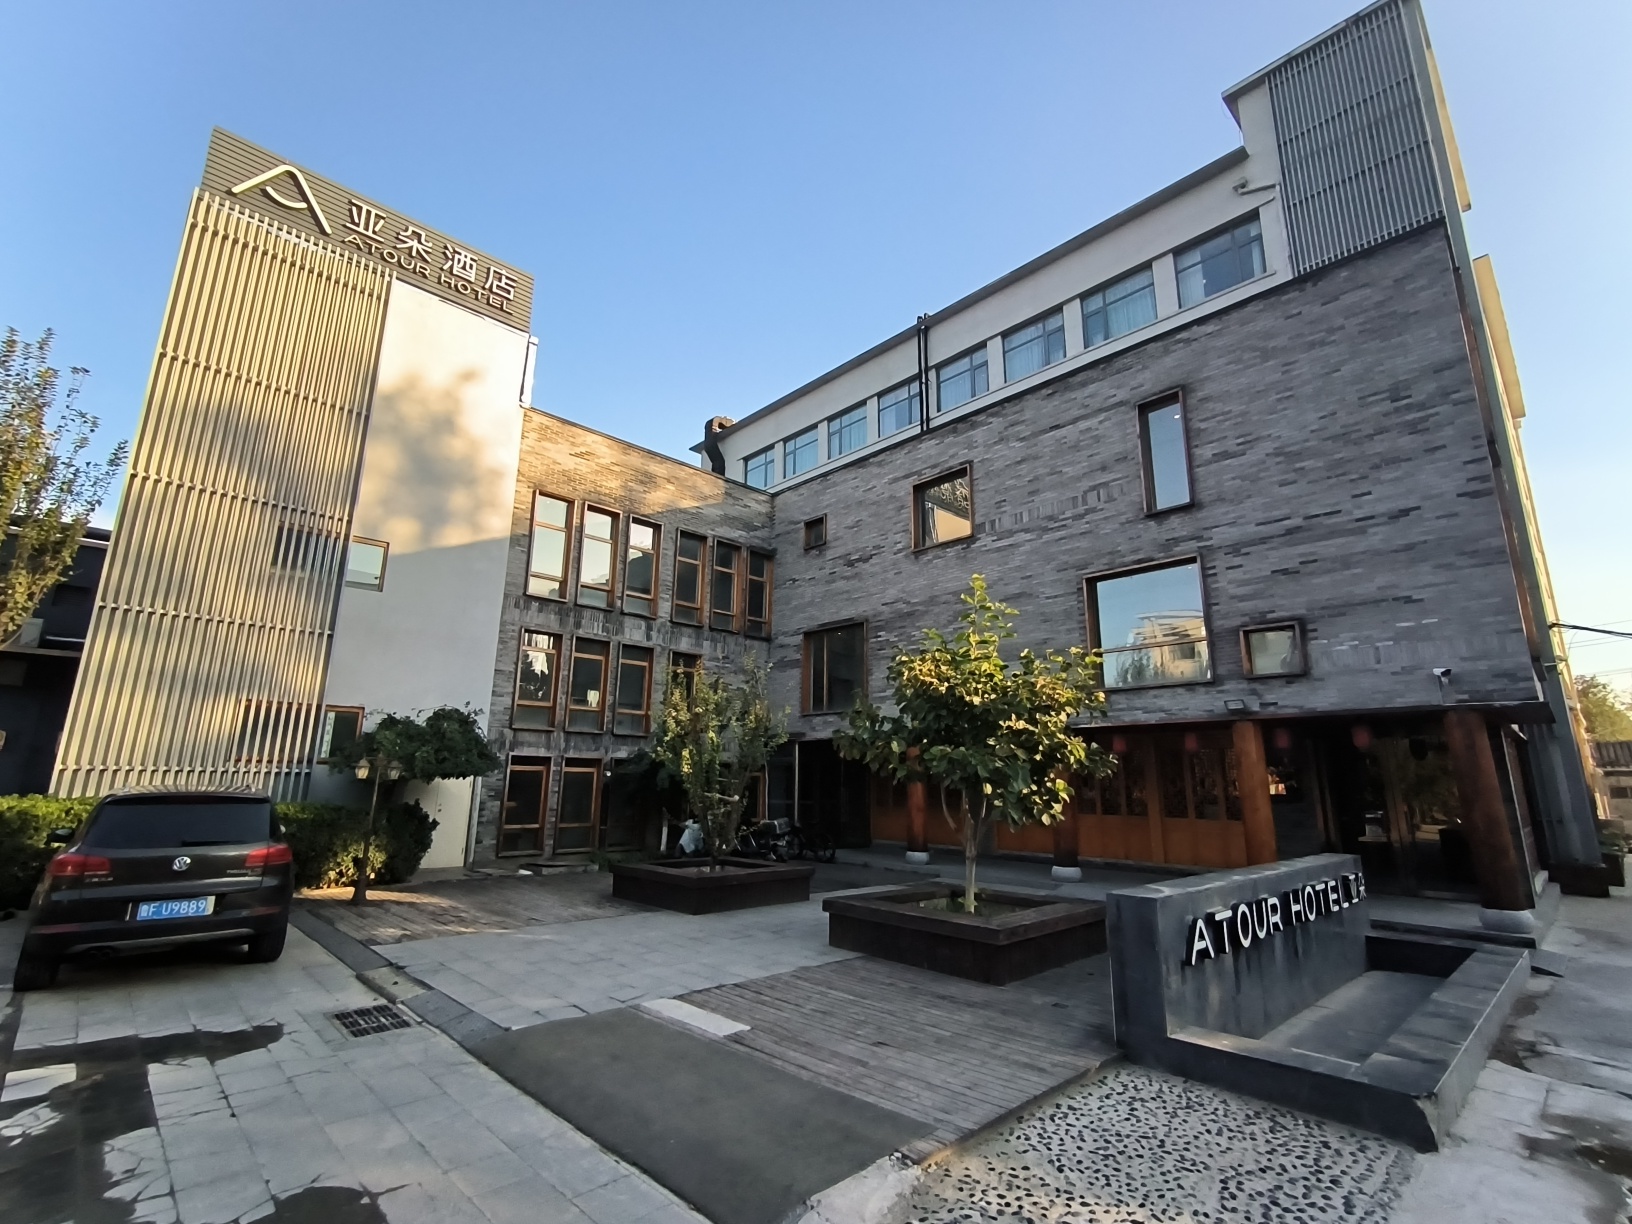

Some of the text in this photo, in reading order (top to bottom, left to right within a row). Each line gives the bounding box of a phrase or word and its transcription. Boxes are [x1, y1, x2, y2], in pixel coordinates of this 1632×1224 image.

[344, 234, 515, 315] ATOUR HOTEL
[345, 199, 518, 301] 亚朵酒店
[1191, 896, 1284, 966] ATOUR
[1289, 879, 1350, 926] HOTEL
